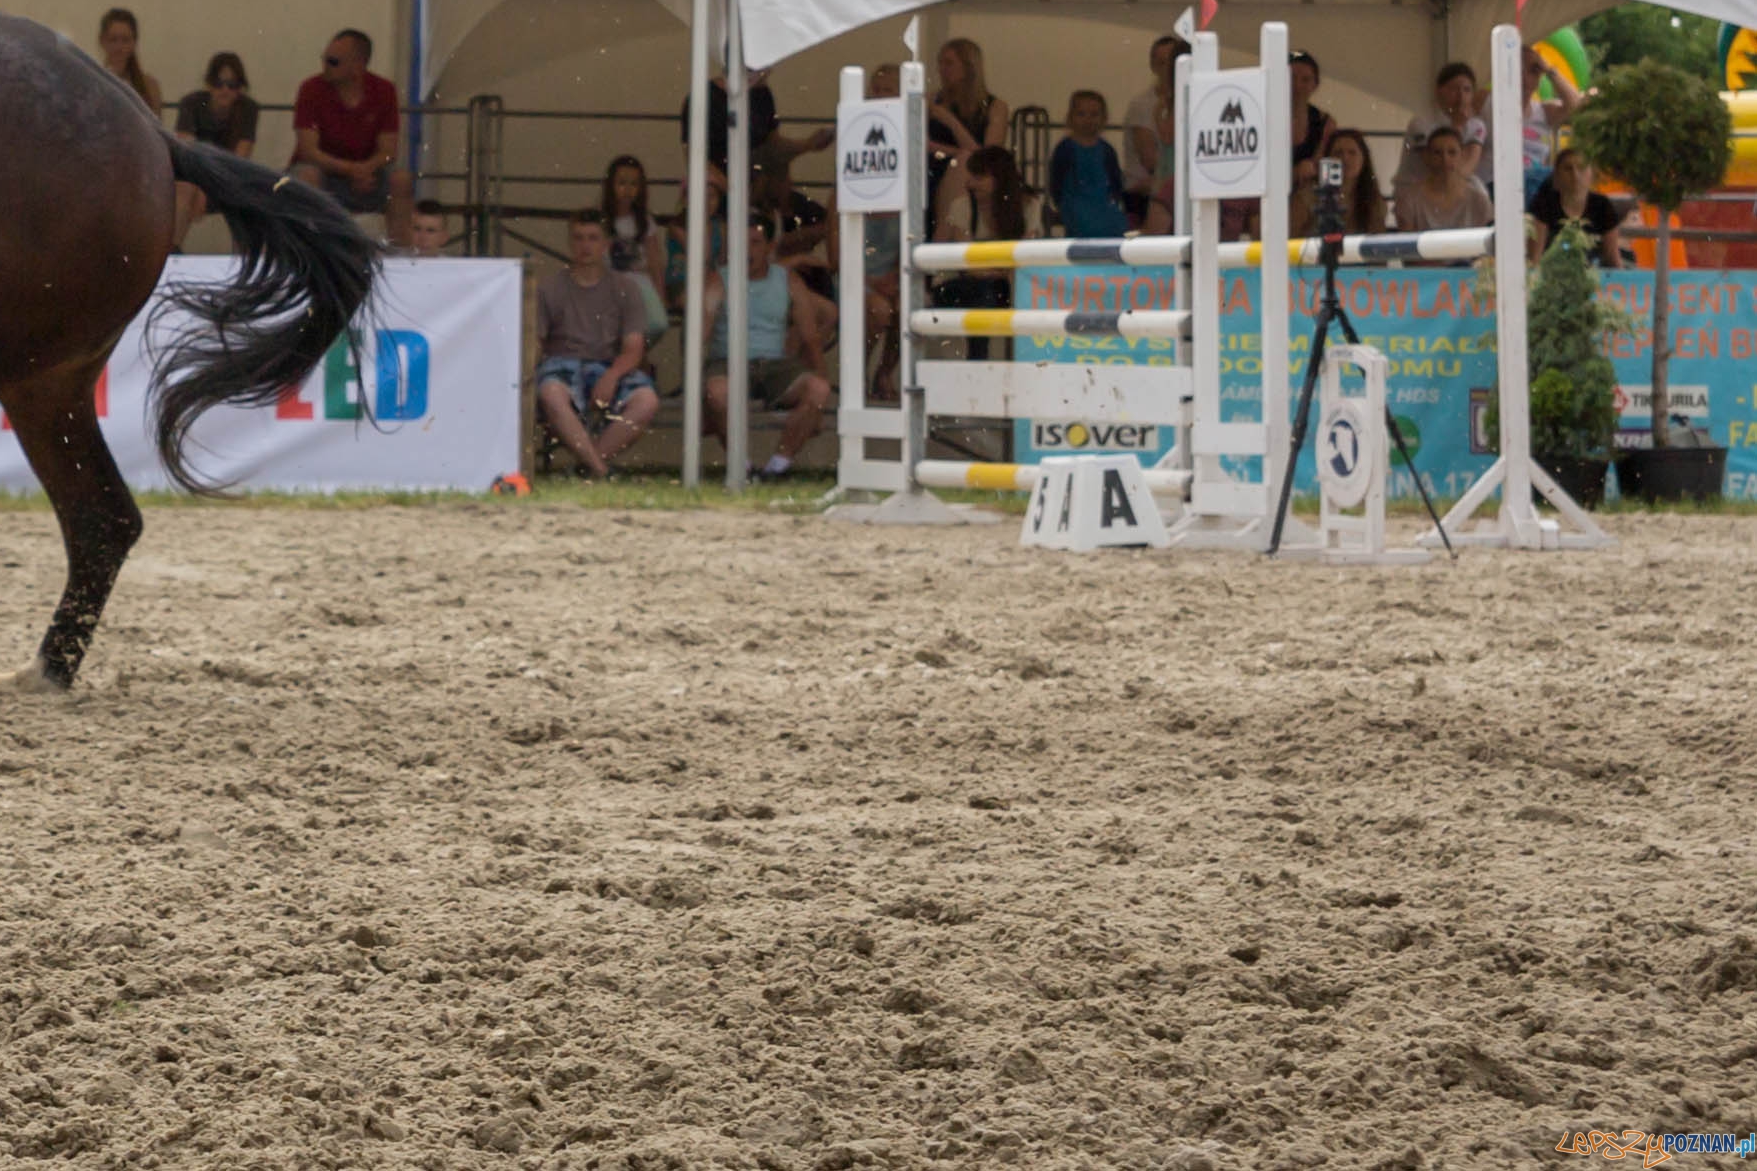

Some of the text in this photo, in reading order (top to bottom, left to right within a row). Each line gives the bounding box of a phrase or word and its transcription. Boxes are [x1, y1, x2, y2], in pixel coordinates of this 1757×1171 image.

[1196, 126, 1259, 157] ALFAKO
[844, 145, 899, 174] ALFAKO
[1100, 469, 1138, 528] A
